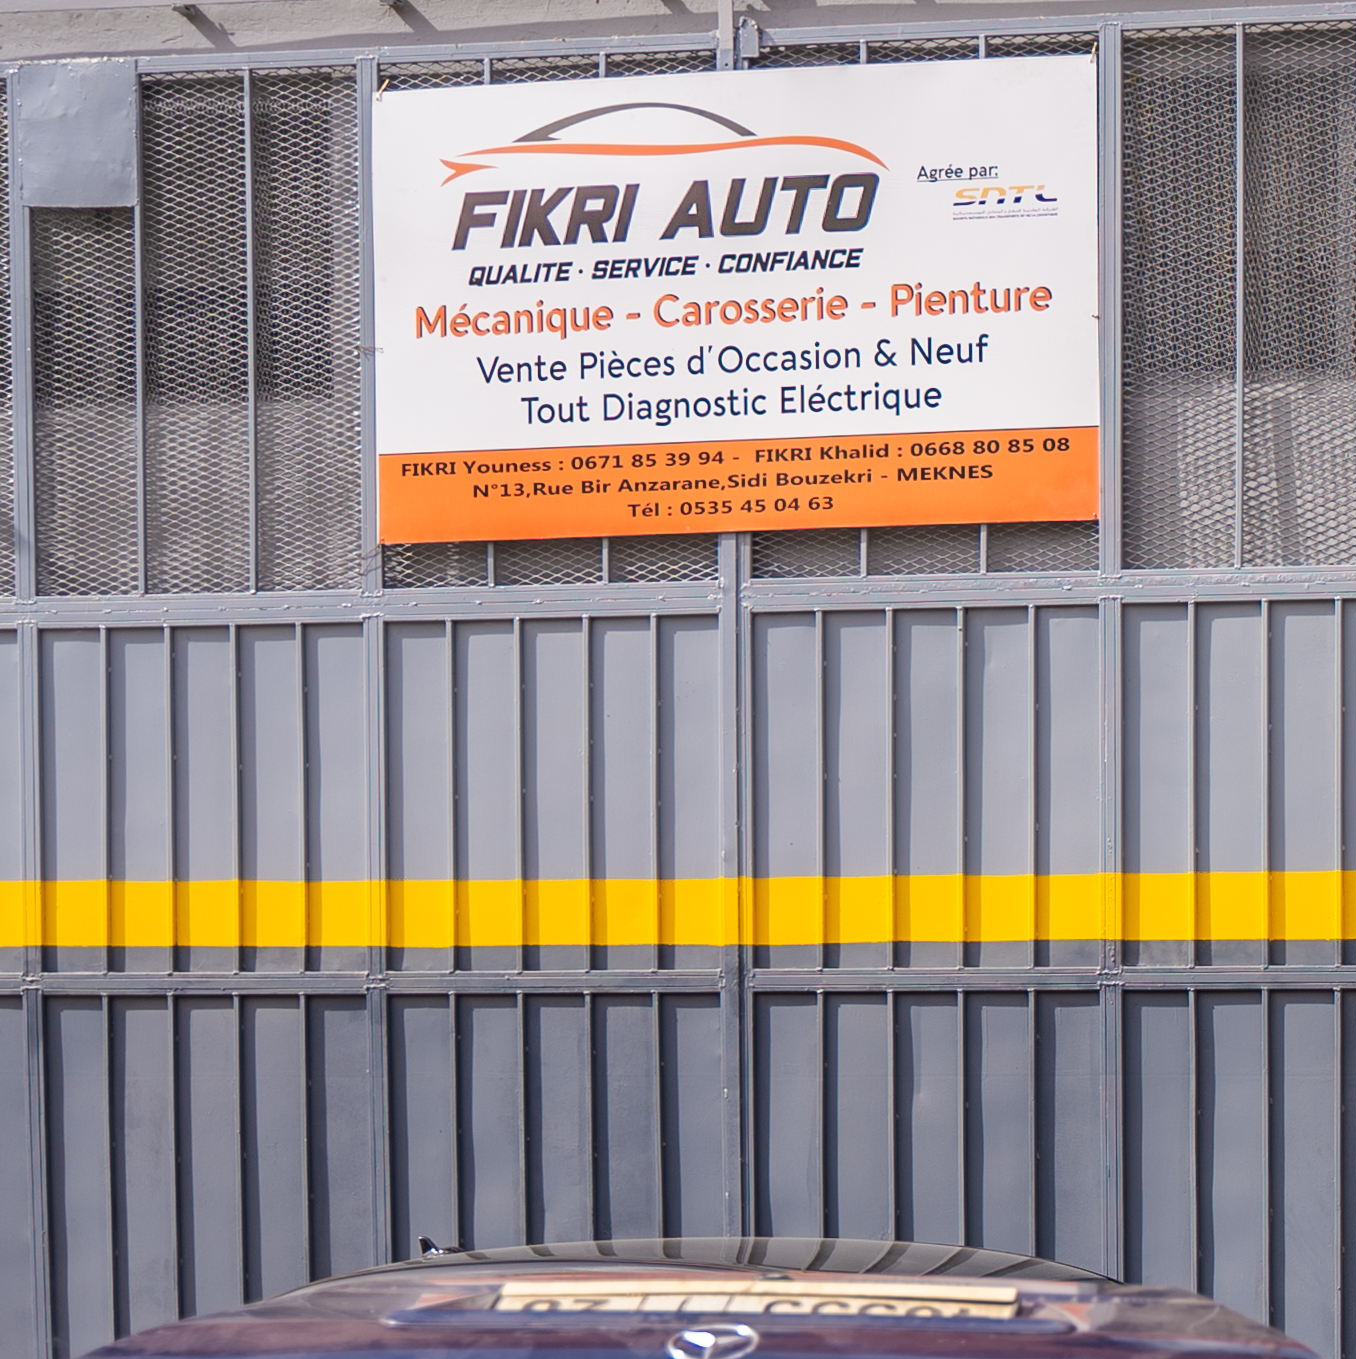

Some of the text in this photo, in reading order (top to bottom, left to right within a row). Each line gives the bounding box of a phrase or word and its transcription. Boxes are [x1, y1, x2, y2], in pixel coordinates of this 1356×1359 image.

[917, 164, 998, 182] Agrée par:
[451, 172, 880, 251] FIKRI AUTO
[468, 261, 573, 286] QUALITE
[591, 256, 699, 279] SERVICE
[718, 248, 864, 273] CONFIANCE
[415, 300, 614, 339] Mécanique
[653, 287, 848, 328] Carosserie
[891, 282, 1053, 317] Pienture
[476, 354, 567, 384] Vente
[580, 350, 675, 379] Pièces
[874, 339, 898, 367] &
[911, 333, 989, 366] Neuf
[521, 382, 942, 426] Tout Diagnostic Eléctrique
[401, 462, 457, 477] FIKRI
[463, 459, 551, 475] Youness
[571, 455, 624, 470] 0671
[631, 453, 657, 468] 85
[665, 452, 691, 466] 39
[698, 451, 724, 465] 94
[754, 448, 812, 463] FIKRI
[820, 444, 889, 460] Khalid
[910, 441, 966, 456] 0668
[973, 440, 1001, 454] 80
[1007, 438, 1035, 453] 85
[1042, 437, 1070, 451] 08
[580, 479, 611, 494] Bir
[776, 469, 872, 486] Bouzekri
[897, 464, 994, 482] MEKNES
[627, 503, 659, 517] Tél
[680, 501, 733, 515] 0535
[740, 499, 766, 513] 45
[773, 497, 800, 512] 04
[808, 496, 834, 510] 63
